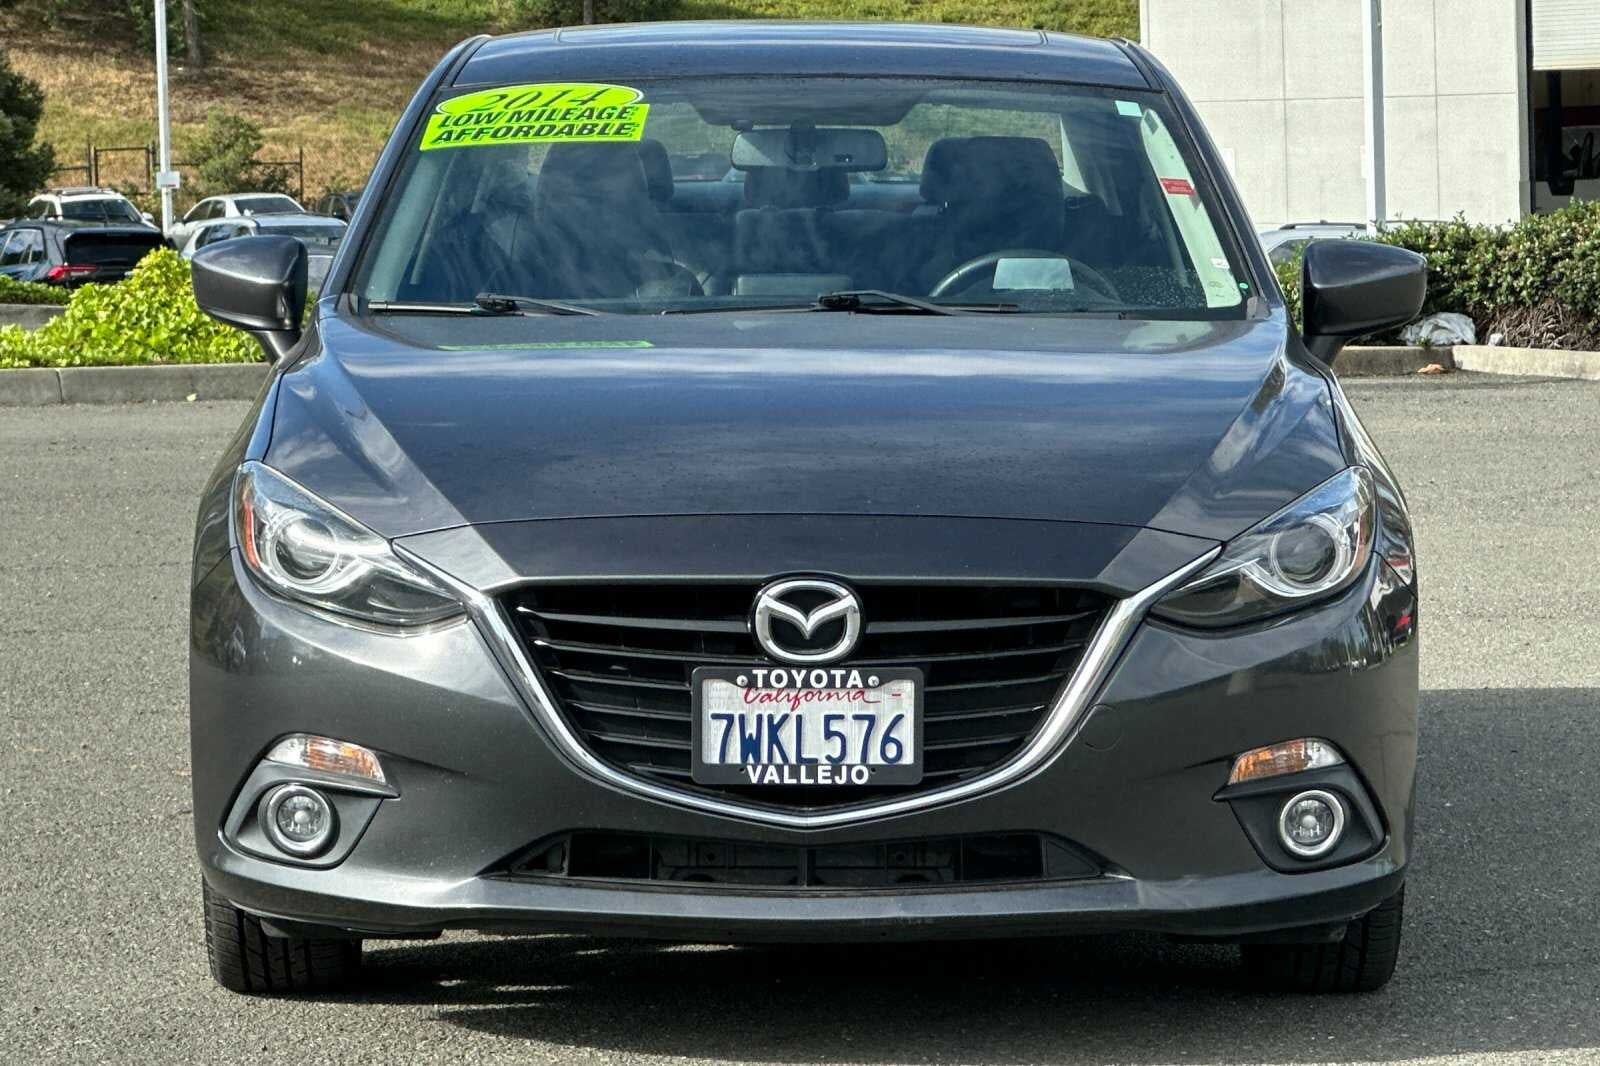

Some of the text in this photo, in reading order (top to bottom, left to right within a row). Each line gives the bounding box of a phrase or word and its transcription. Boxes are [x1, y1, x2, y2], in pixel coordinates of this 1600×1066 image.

[468, 88, 610, 111] 2014
[439, 105, 639, 128] LOW MILEAGE
[430, 122, 640, 144] AFFORDABLE
[752, 669, 863, 688] TOYOTA
[742, 686, 881, 712] California
[710, 712, 905, 764] 7WKL576
[746, 765, 869, 784] VALLEJO
